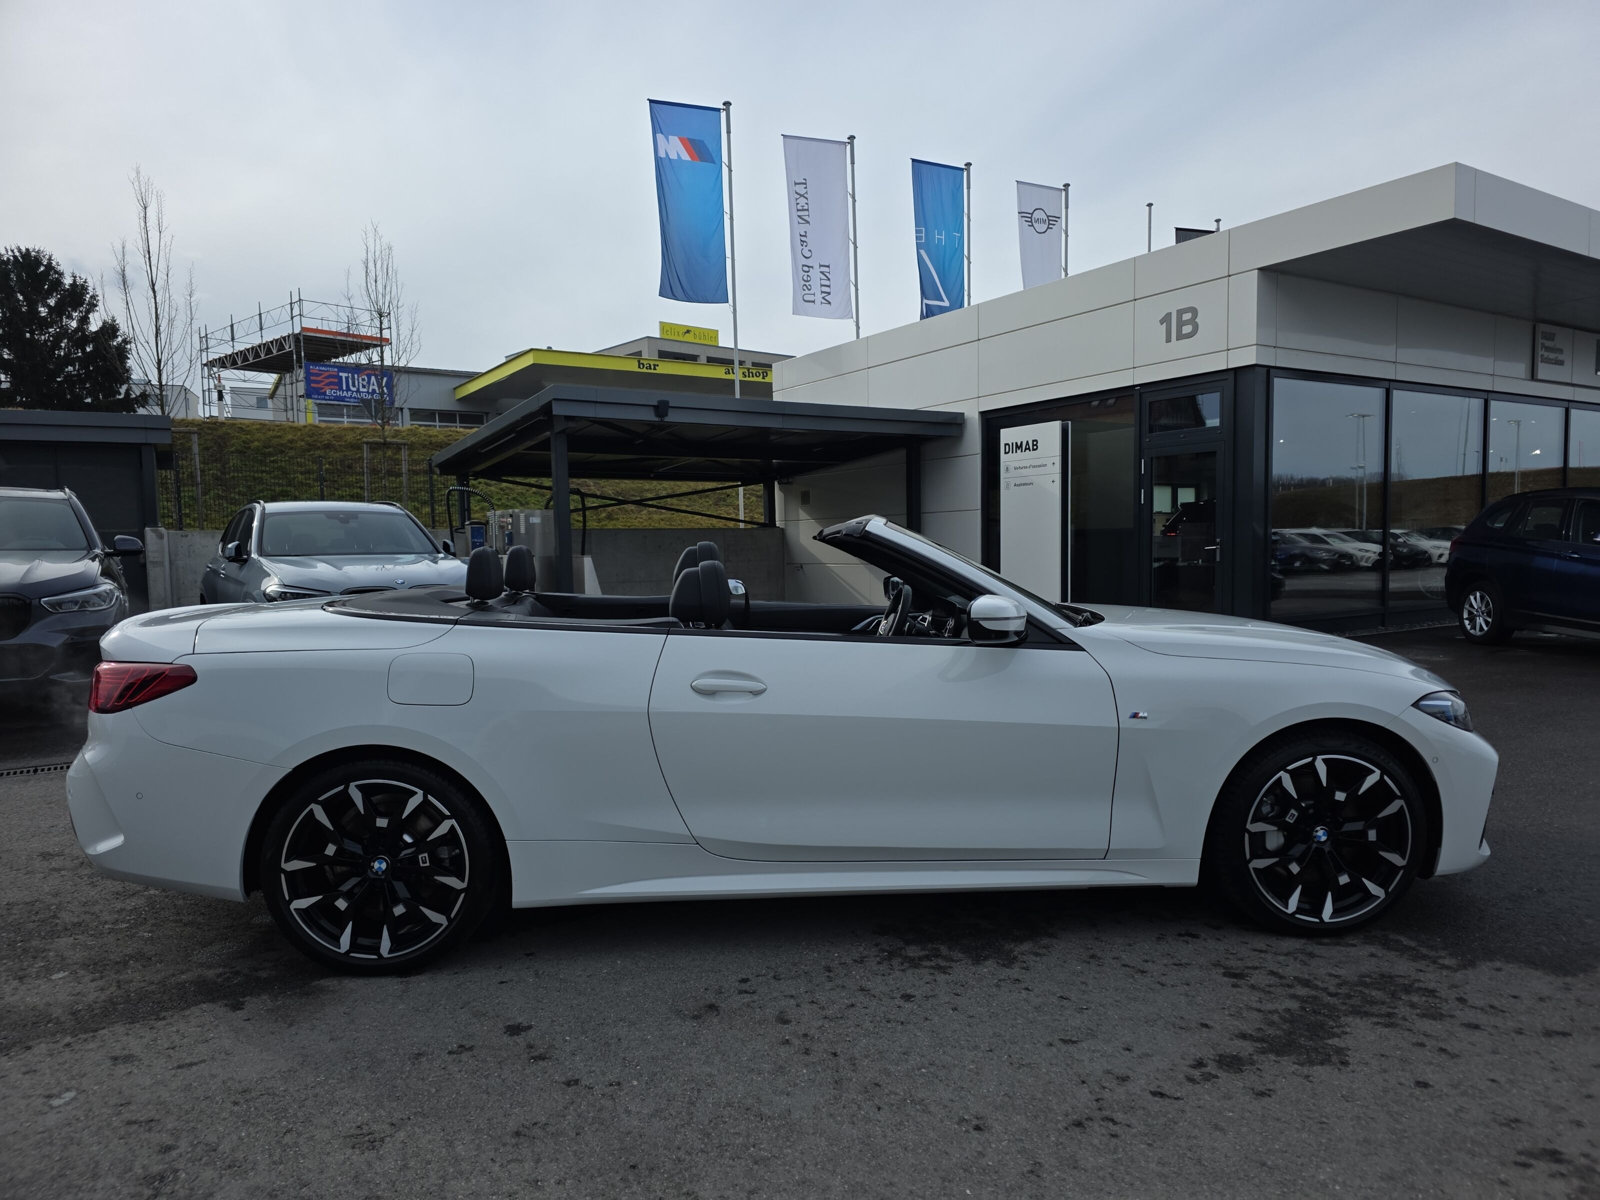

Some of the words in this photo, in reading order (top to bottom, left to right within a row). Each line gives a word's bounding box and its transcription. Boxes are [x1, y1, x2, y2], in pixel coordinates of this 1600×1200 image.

[1159, 306, 1199, 343] 1B
[637, 360, 659, 371] bar
[742, 367, 769, 380] shop
[1004, 439, 1039, 454] DIMAB
